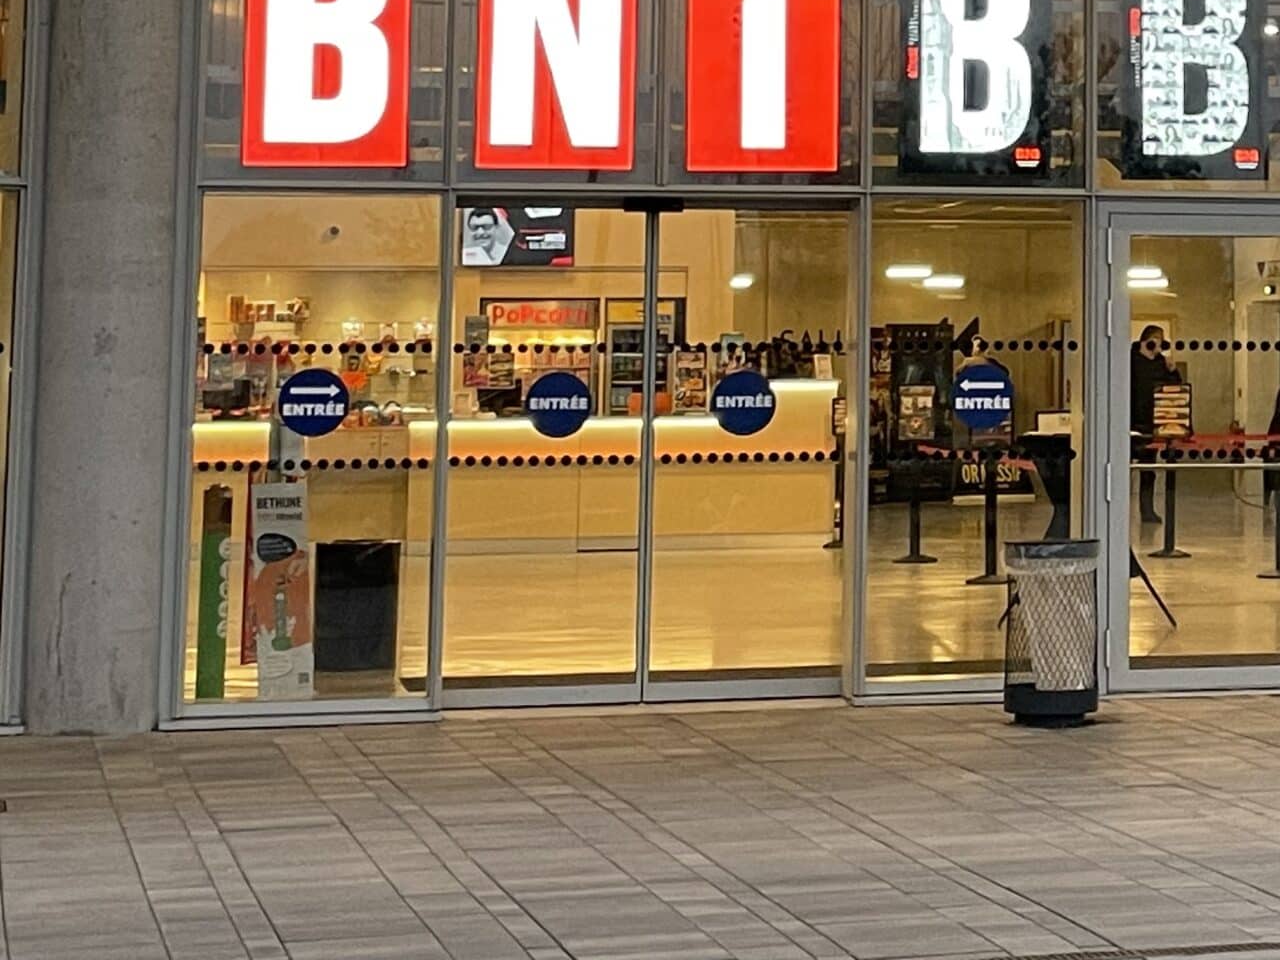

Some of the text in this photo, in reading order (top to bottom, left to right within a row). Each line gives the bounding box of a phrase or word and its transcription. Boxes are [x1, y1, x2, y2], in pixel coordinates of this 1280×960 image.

[529, 395, 588, 410] ENTRÉE
[716, 393, 773, 408] ENTRÉE
[955, 394, 1010, 409] ENTRÉE
[282, 401, 345, 416] ENTRÉE
